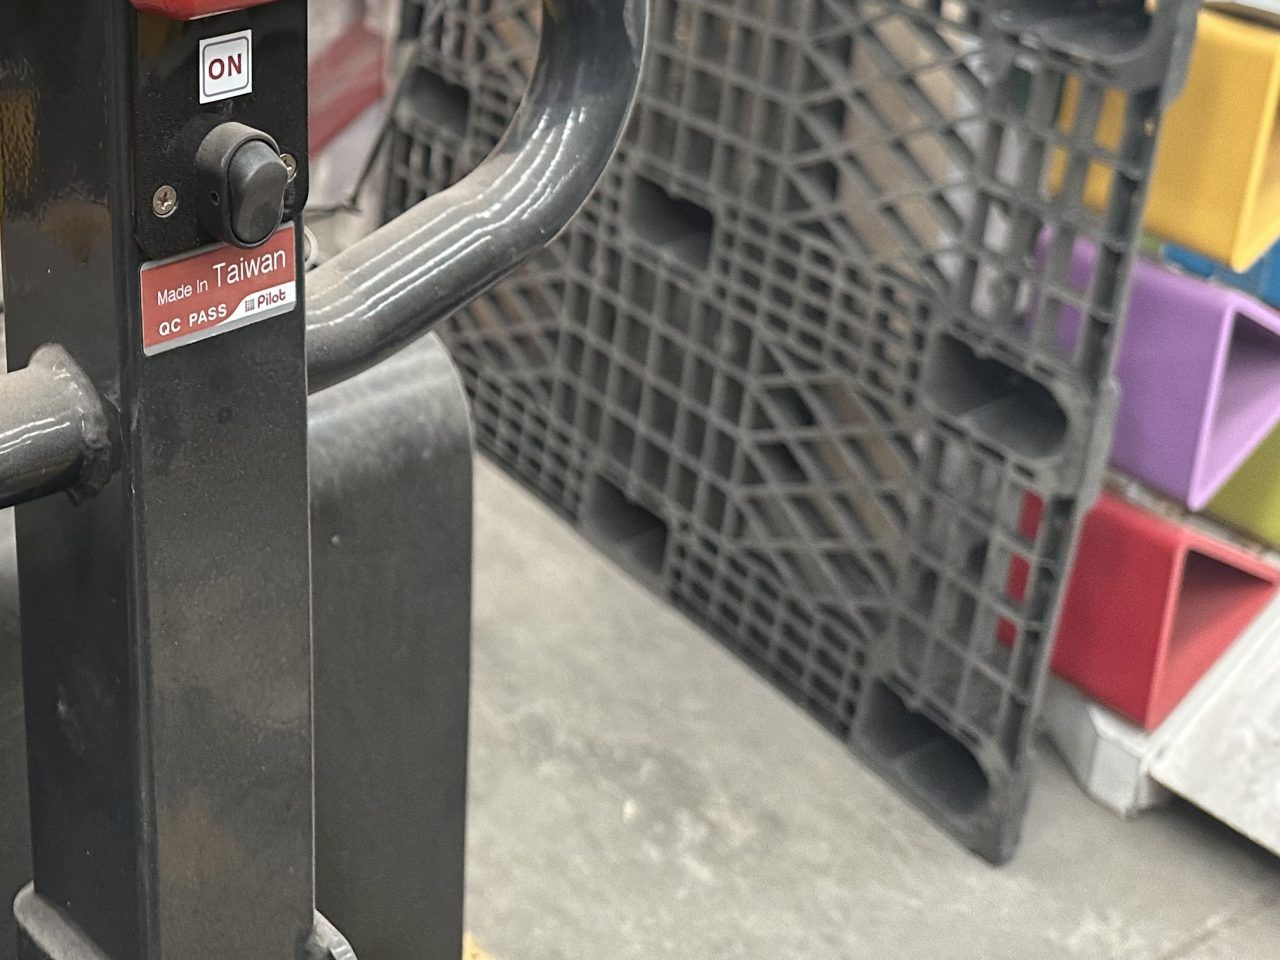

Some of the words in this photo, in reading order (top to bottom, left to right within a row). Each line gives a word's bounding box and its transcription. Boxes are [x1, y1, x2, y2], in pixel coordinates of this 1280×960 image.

[208, 53, 242, 80] ON
[157, 285, 192, 305] Made
[196, 279, 208, 293] In
[213, 249, 286, 287] Taiwan
[257, 288, 286, 308] Pilot
[158, 318, 181, 336] QC
[189, 304, 227, 328] PASS
